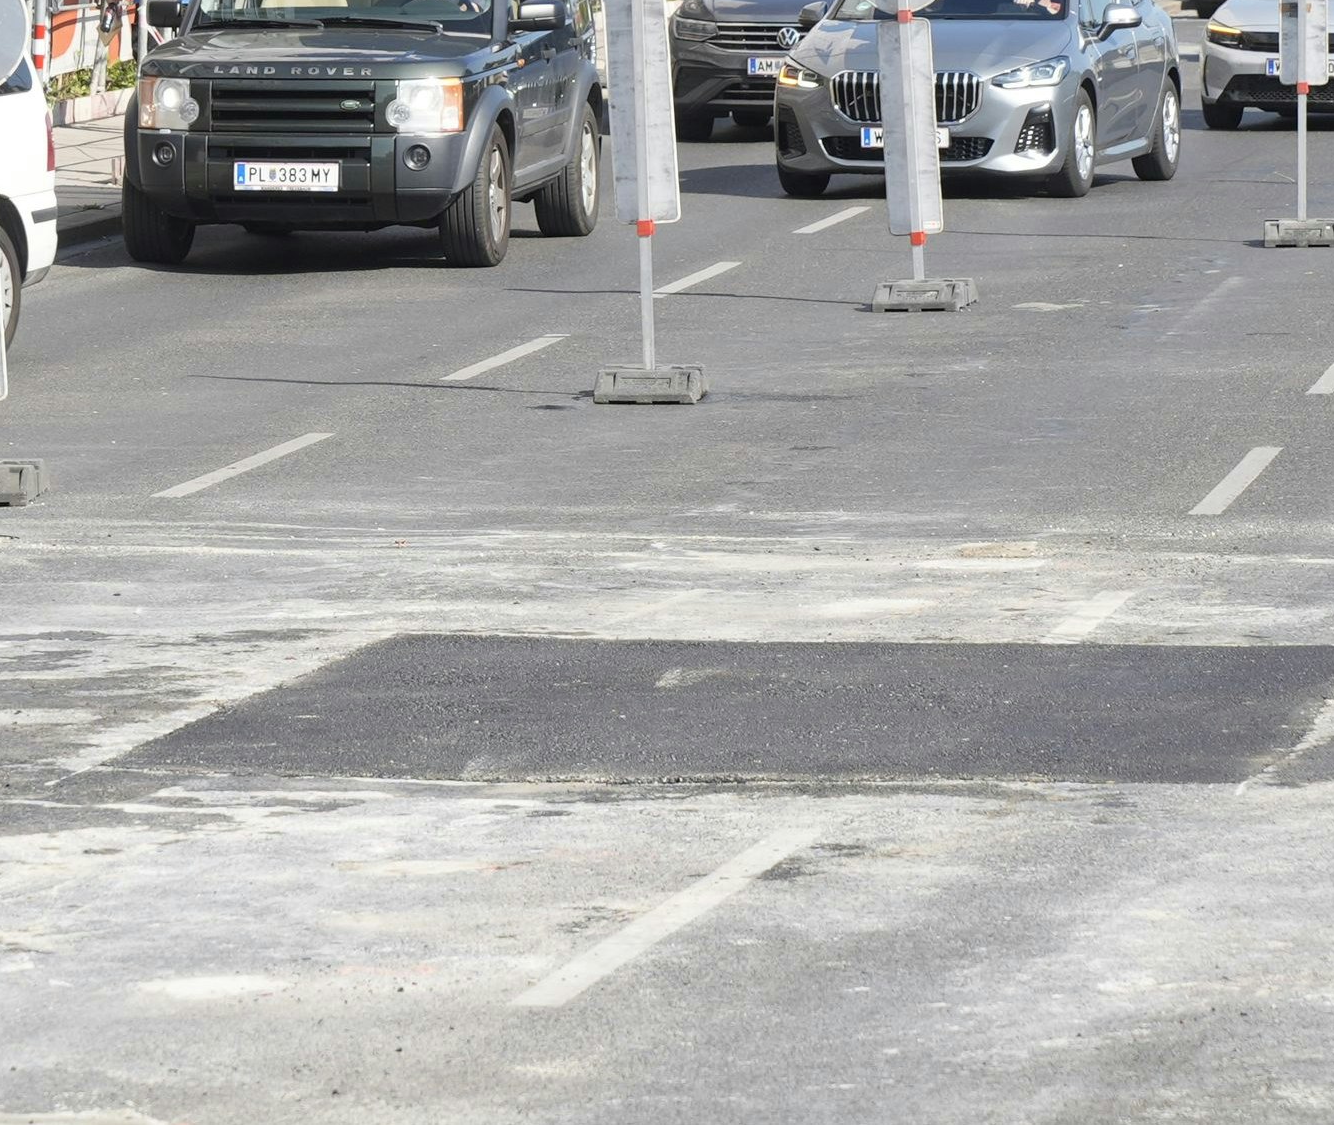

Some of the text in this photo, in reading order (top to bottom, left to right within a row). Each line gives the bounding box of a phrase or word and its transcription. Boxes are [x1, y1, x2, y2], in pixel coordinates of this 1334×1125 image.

[213, 65, 373, 76] LAND ROVER
[249, 167, 331, 183] PL 383 MY
